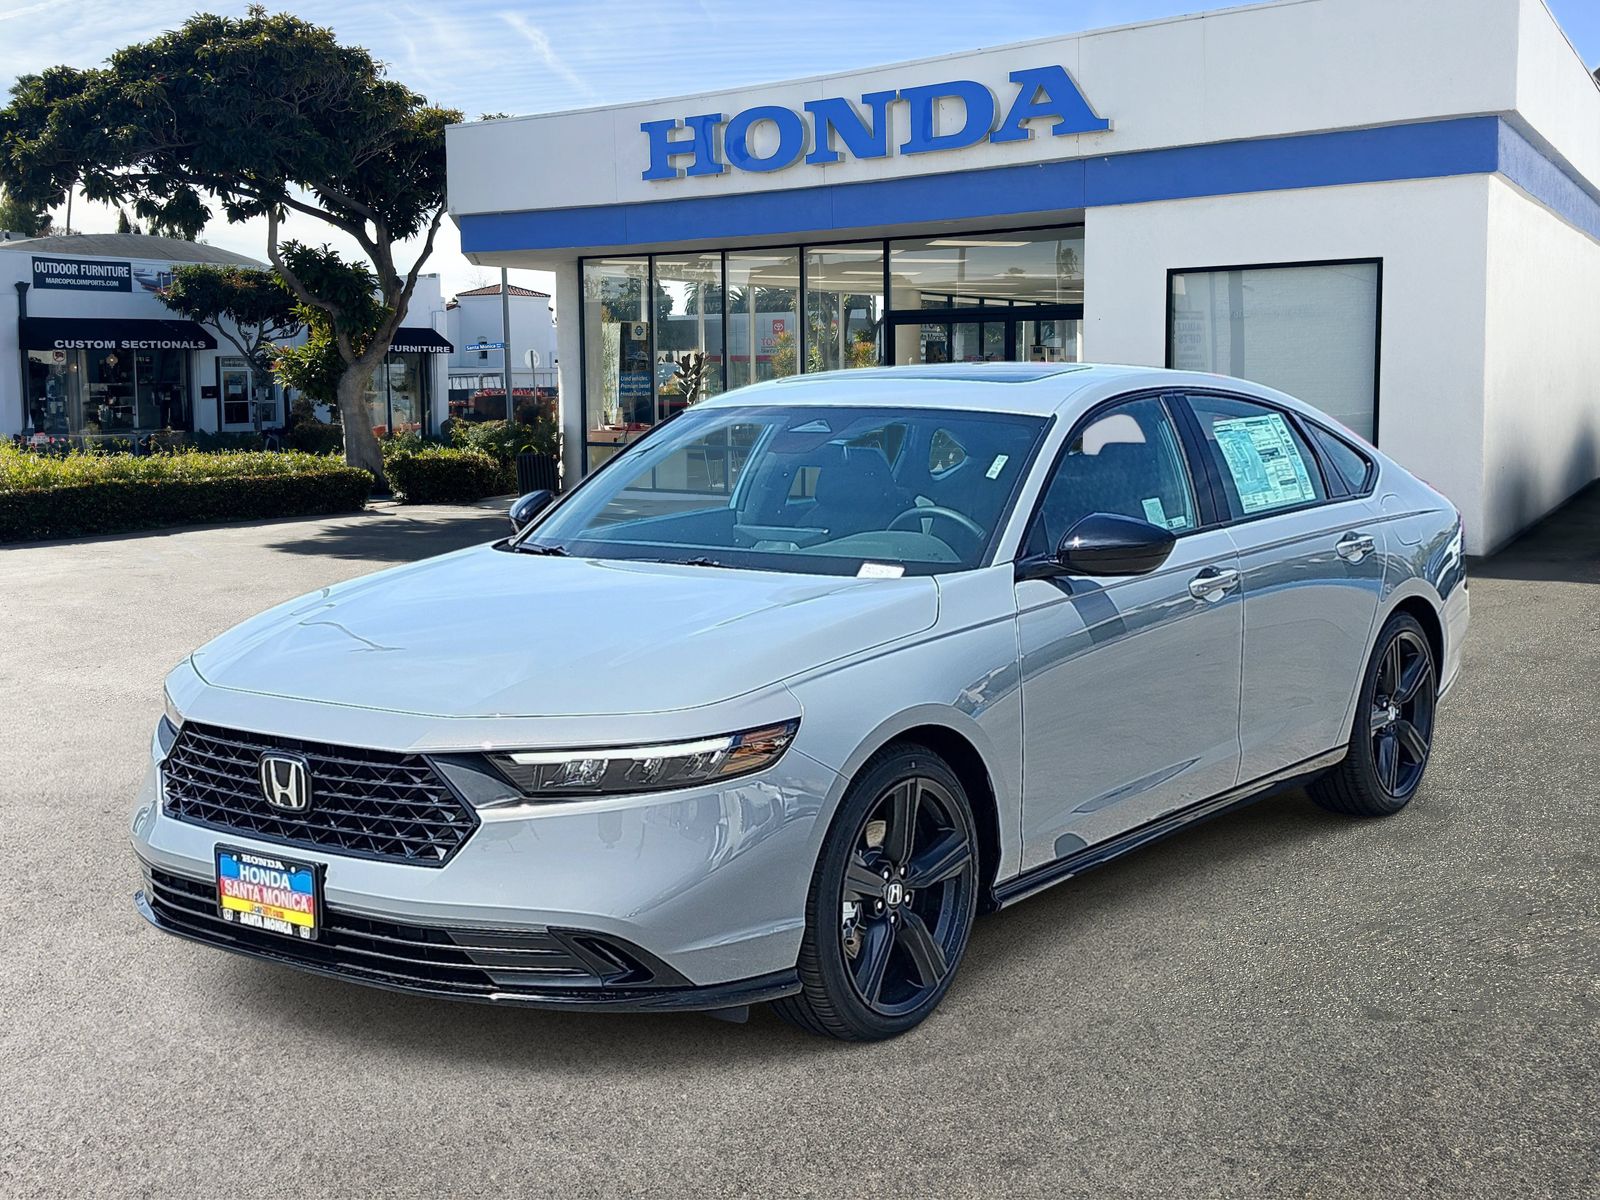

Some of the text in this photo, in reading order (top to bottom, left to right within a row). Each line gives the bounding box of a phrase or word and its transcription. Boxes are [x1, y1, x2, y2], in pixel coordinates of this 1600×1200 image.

[640, 65, 1112, 182] HONDA
[34, 261, 130, 278] OUTDOOR FURNITURE
[45, 277, 119, 287] MARCOPOLOIMPORTS.COM
[54, 339, 206, 349] CUSTOM SECTIONALS
[388, 344, 450, 353] FURNITURE
[241, 854, 285, 870] HONDA
[240, 864, 291, 891] HONDA
[224, 880, 261, 902] SANTA
[263, 887, 310, 913] MONICA
[240, 912, 263, 929] SANTA
[263, 915, 293, 935] MONICA
